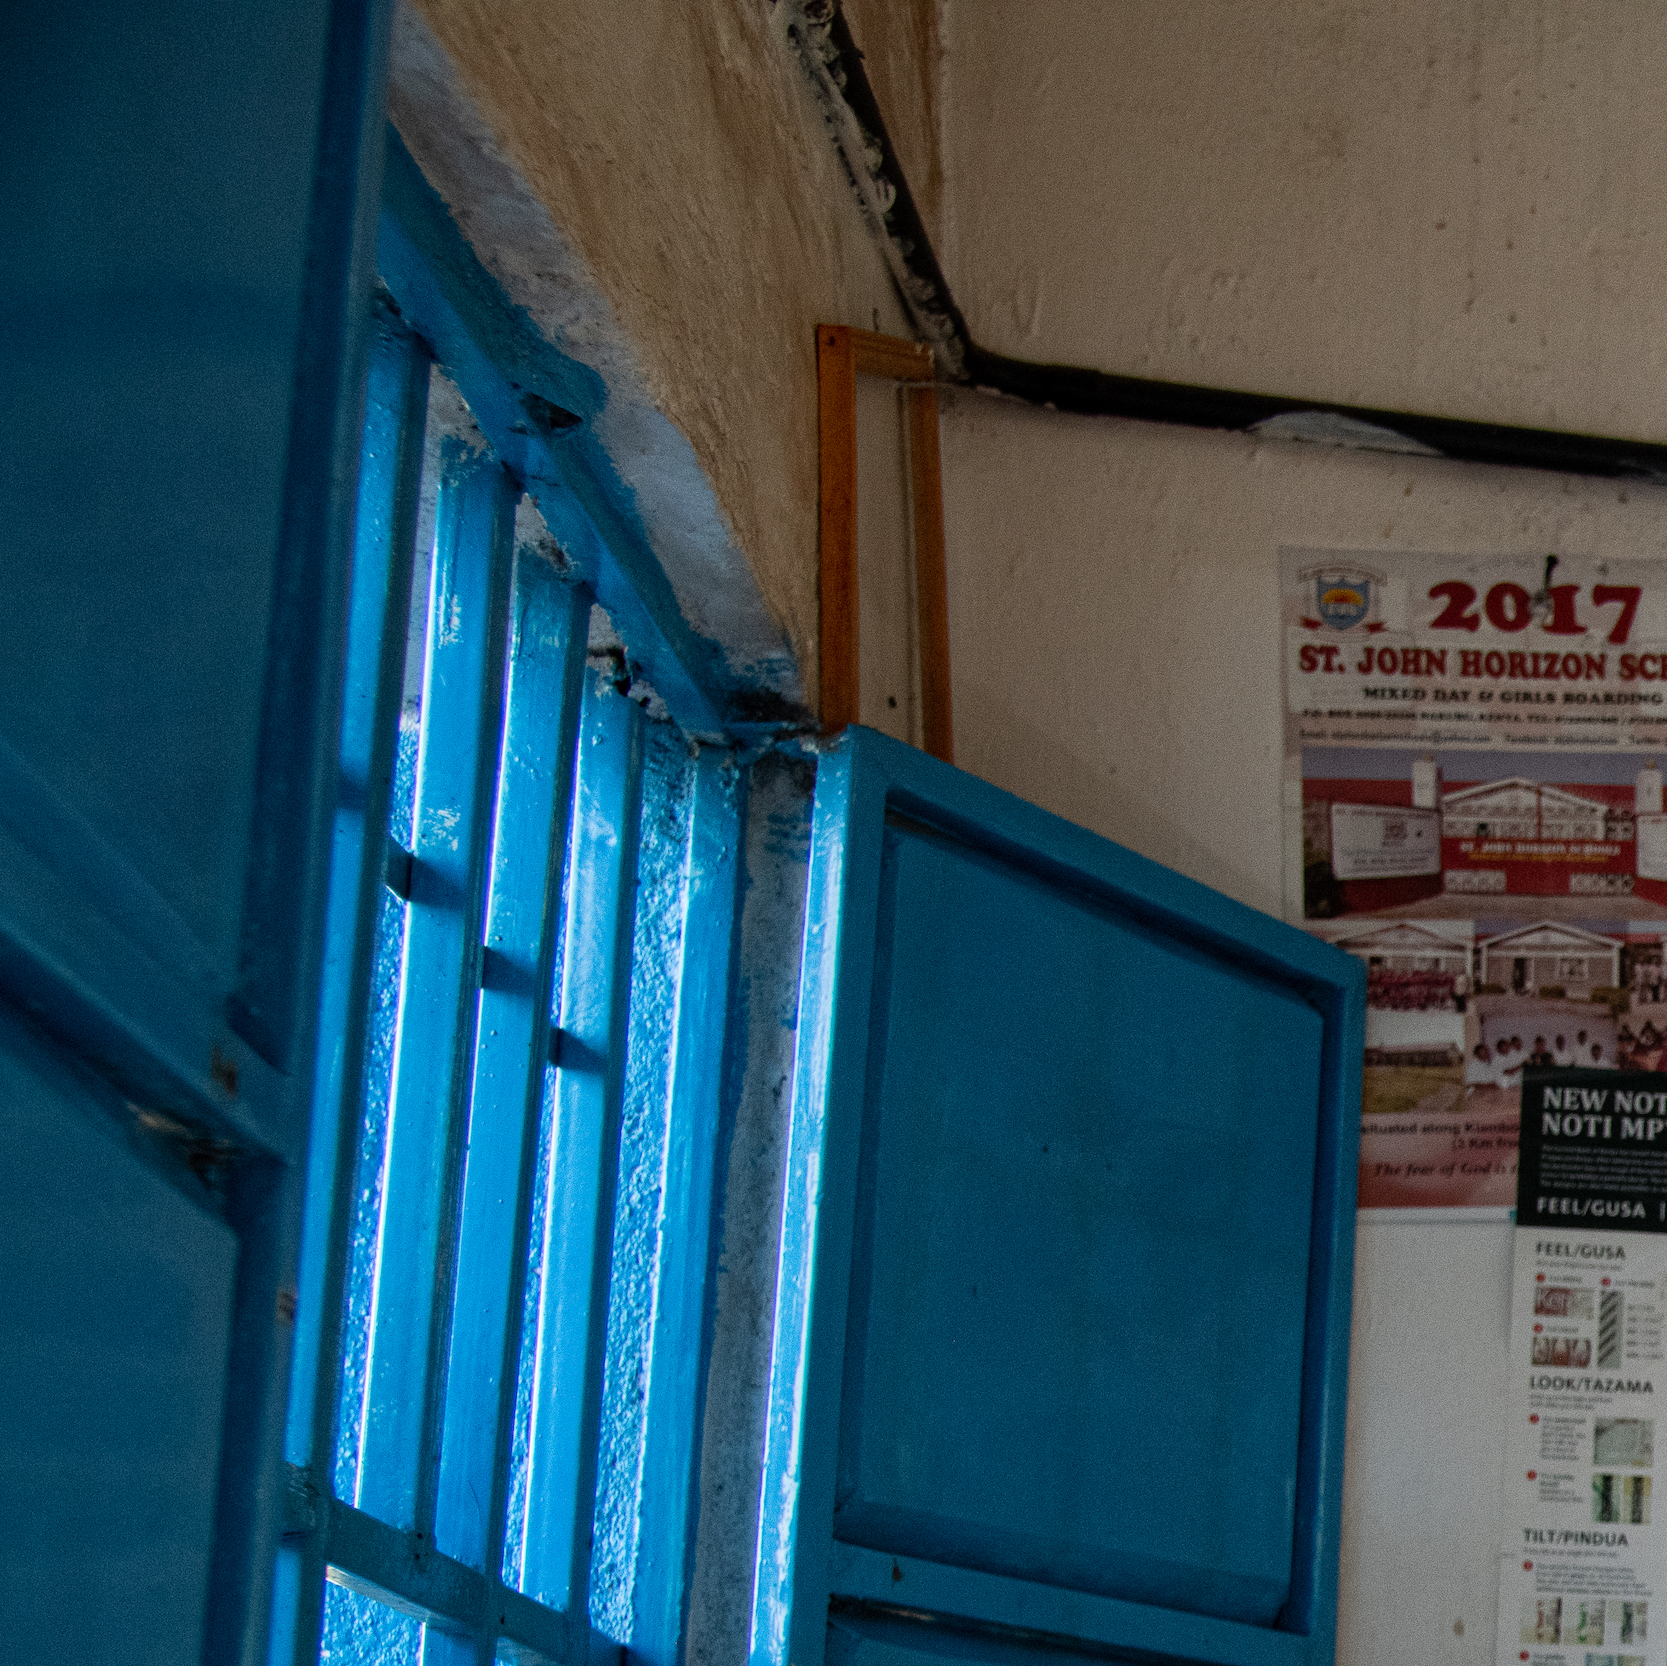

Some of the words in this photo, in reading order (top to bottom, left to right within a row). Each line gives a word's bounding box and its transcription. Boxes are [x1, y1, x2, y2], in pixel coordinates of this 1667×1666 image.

[1429, 581, 1642, 645] 2017
[1300, 645, 1345, 674] ST.
[1357, 647, 1447, 677] JOHN
[1459, 650, 1606, 680] HORIZON
[1364, 687, 1426, 701] MIXED
[1434, 689, 1471, 702] DAY
[1501, 691, 1556, 704] GIRLS
[1563, 692, 1662, 705] BOARDING
[1543, 1087, 1607, 1114] NEW
[1542, 1113, 1612, 1139] NOTI
[1537, 1198, 1646, 1219] FEEL/GUSA
[1536, 1242, 1626, 1260] FEEL/GUSA
[1530, 1375, 1654, 1394] LOOK/TAZAMA
[1523, 1529, 1629, 1547] TILT/PINDUA
